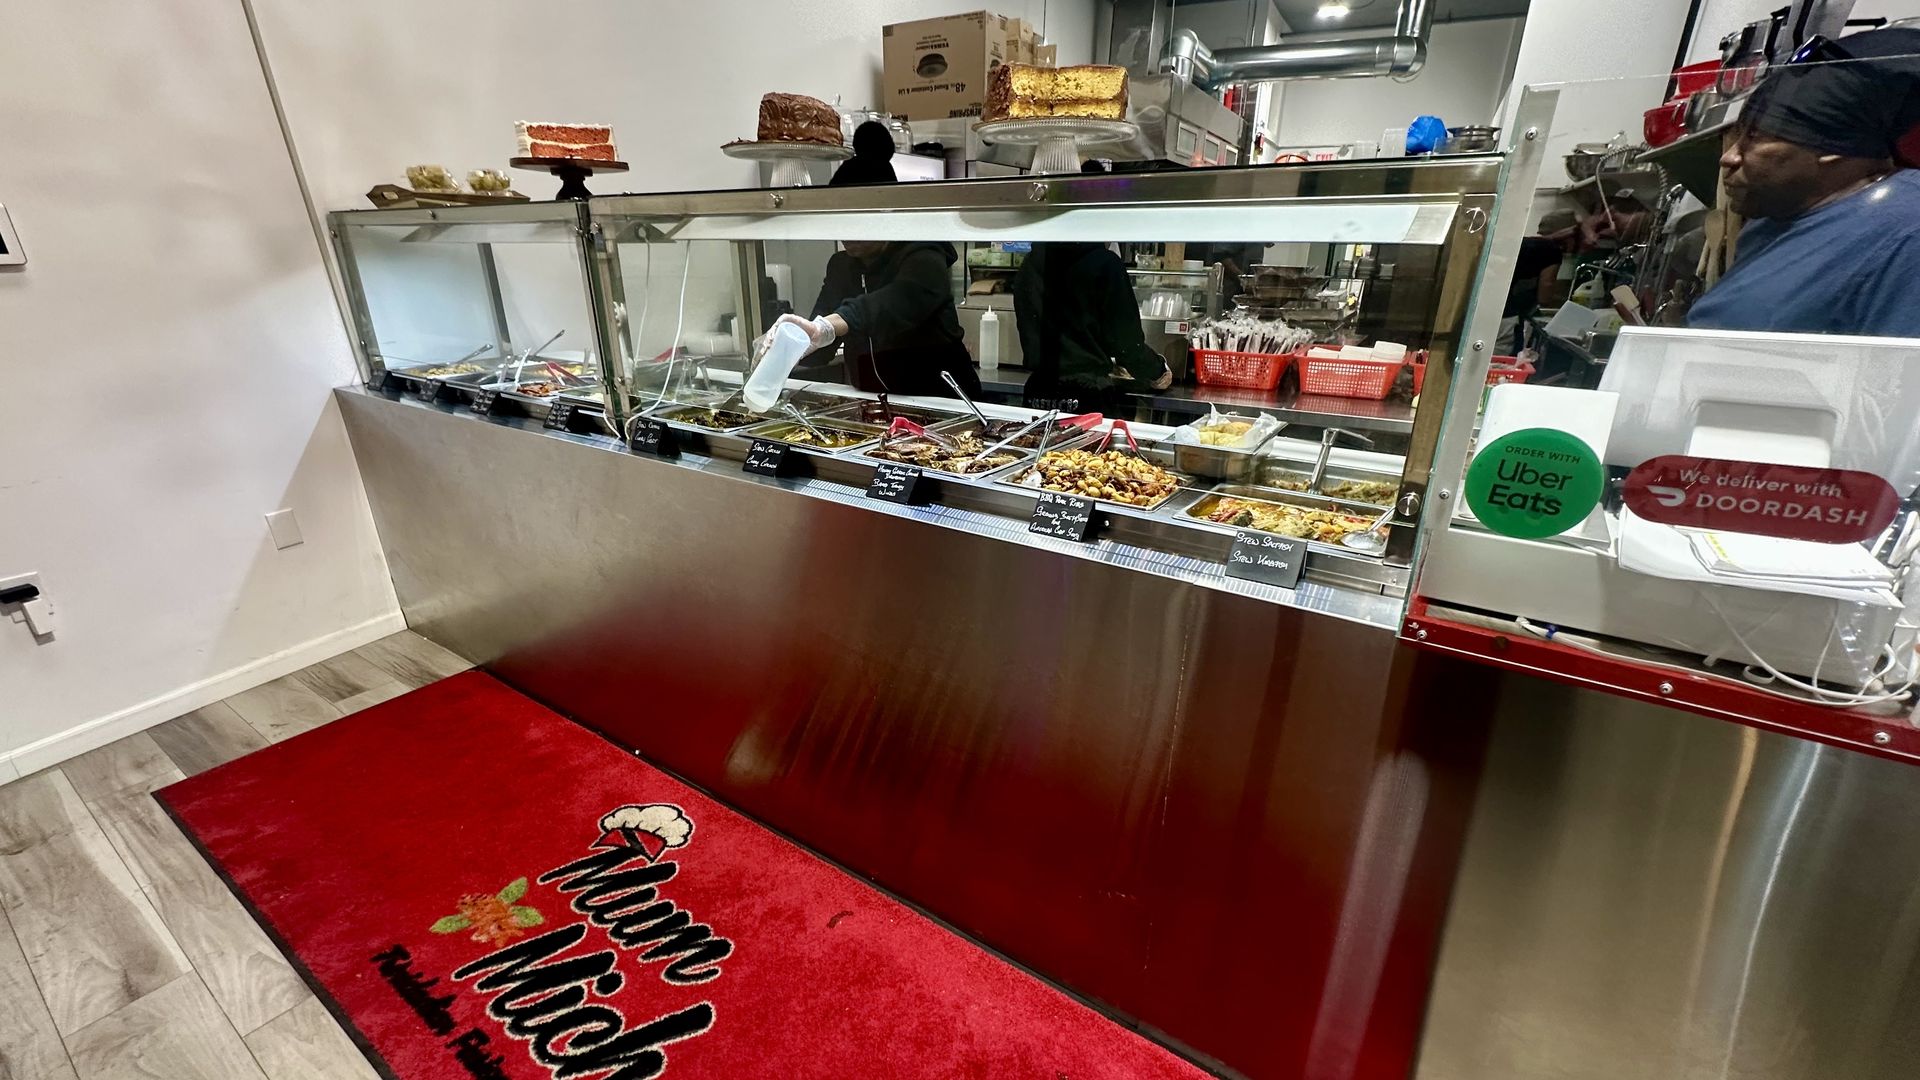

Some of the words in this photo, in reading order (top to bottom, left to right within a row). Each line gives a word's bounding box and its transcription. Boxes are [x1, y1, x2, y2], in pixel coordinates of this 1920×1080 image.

[1505, 445, 1545, 459] ORDER
[1549, 451, 1580, 464] WITH
[1497, 459, 1573, 490] Uber
[1679, 469, 1711, 485] We
[1716, 470, 1790, 492] deliver
[1794, 481, 1842, 497] with
[1487, 483, 1562, 515] Eats
[1695, 493, 1867, 527] DOORDASH
[537, 846, 735, 986] Mum
